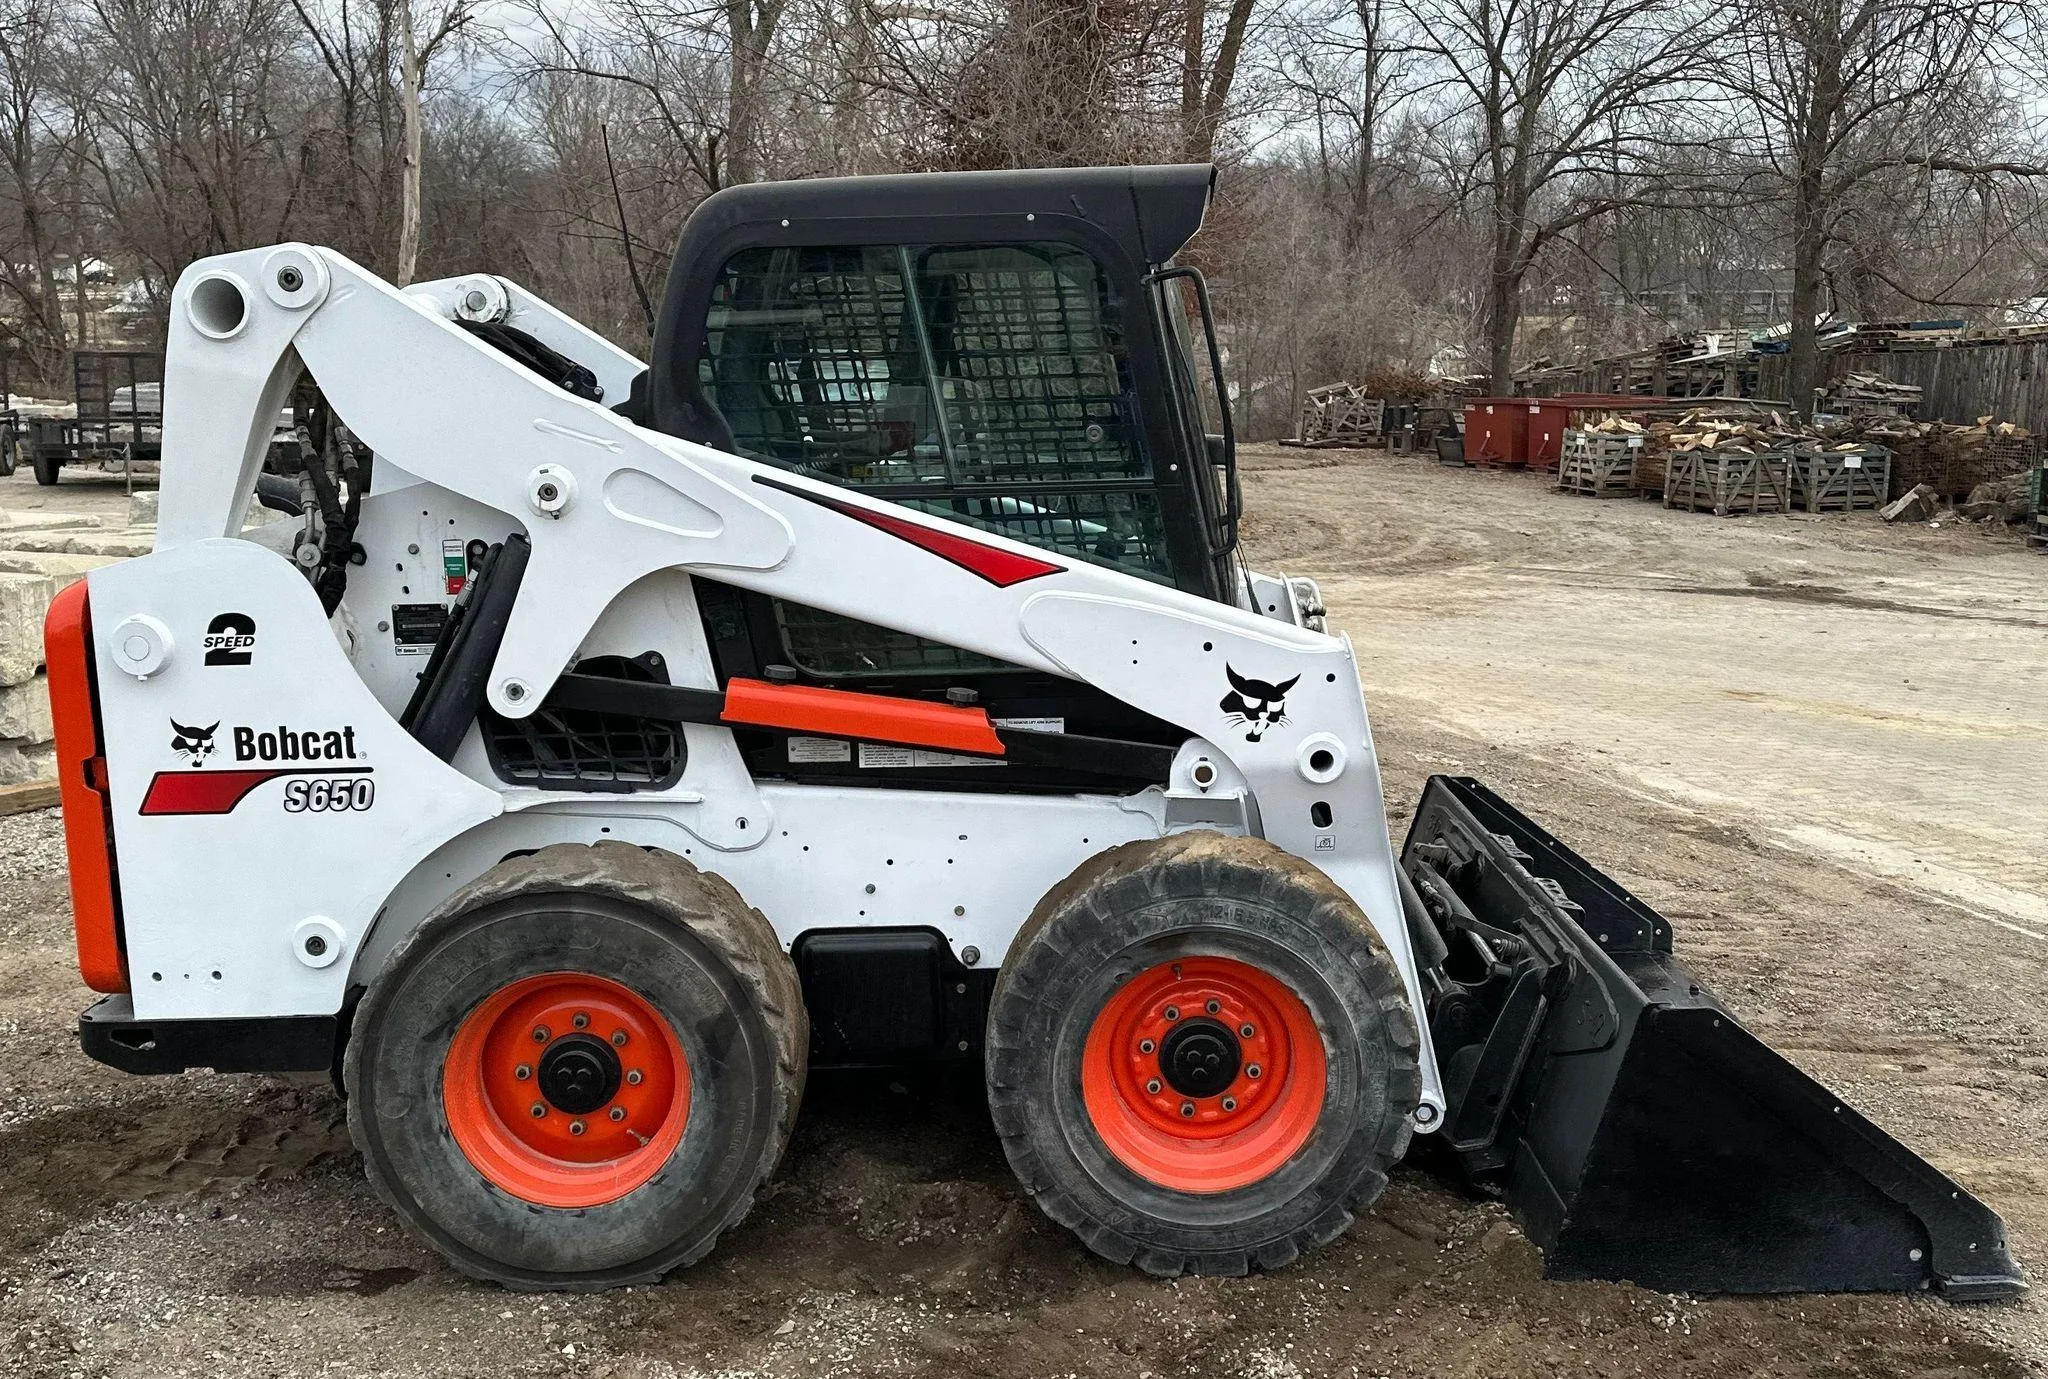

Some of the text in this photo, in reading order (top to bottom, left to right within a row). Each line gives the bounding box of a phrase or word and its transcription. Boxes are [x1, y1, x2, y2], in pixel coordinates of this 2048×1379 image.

[204, 612, 256, 667] 2
[204, 635, 256, 649] SPEED
[233, 725, 357, 762] Bobcat
[284, 778, 375, 813] S650
